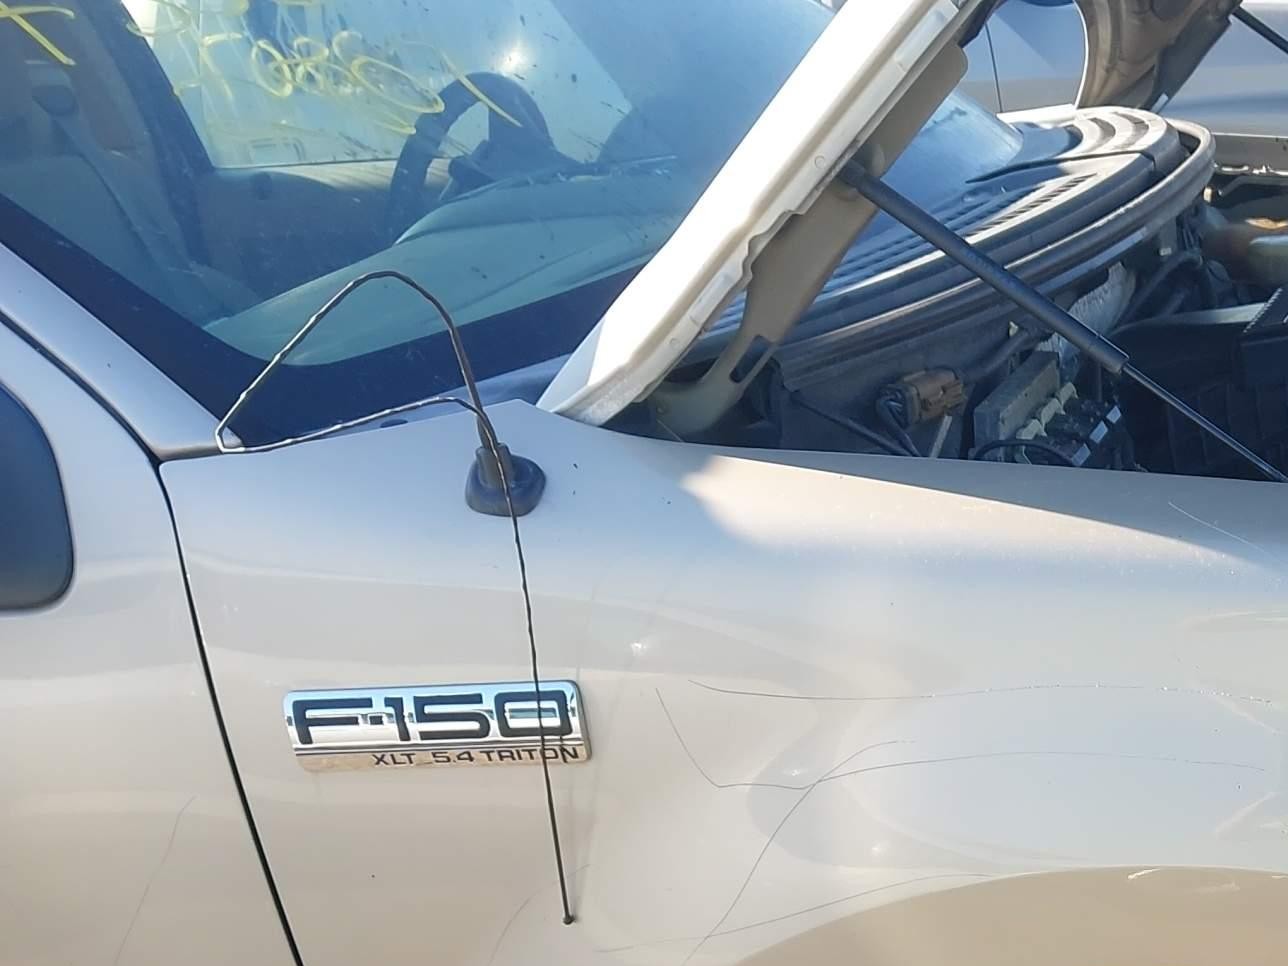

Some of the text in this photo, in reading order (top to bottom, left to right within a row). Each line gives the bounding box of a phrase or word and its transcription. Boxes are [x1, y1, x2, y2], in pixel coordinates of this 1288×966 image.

[292, 690, 573, 745] F-150
[372, 747, 581, 766] XLT 5.4 TRITON
